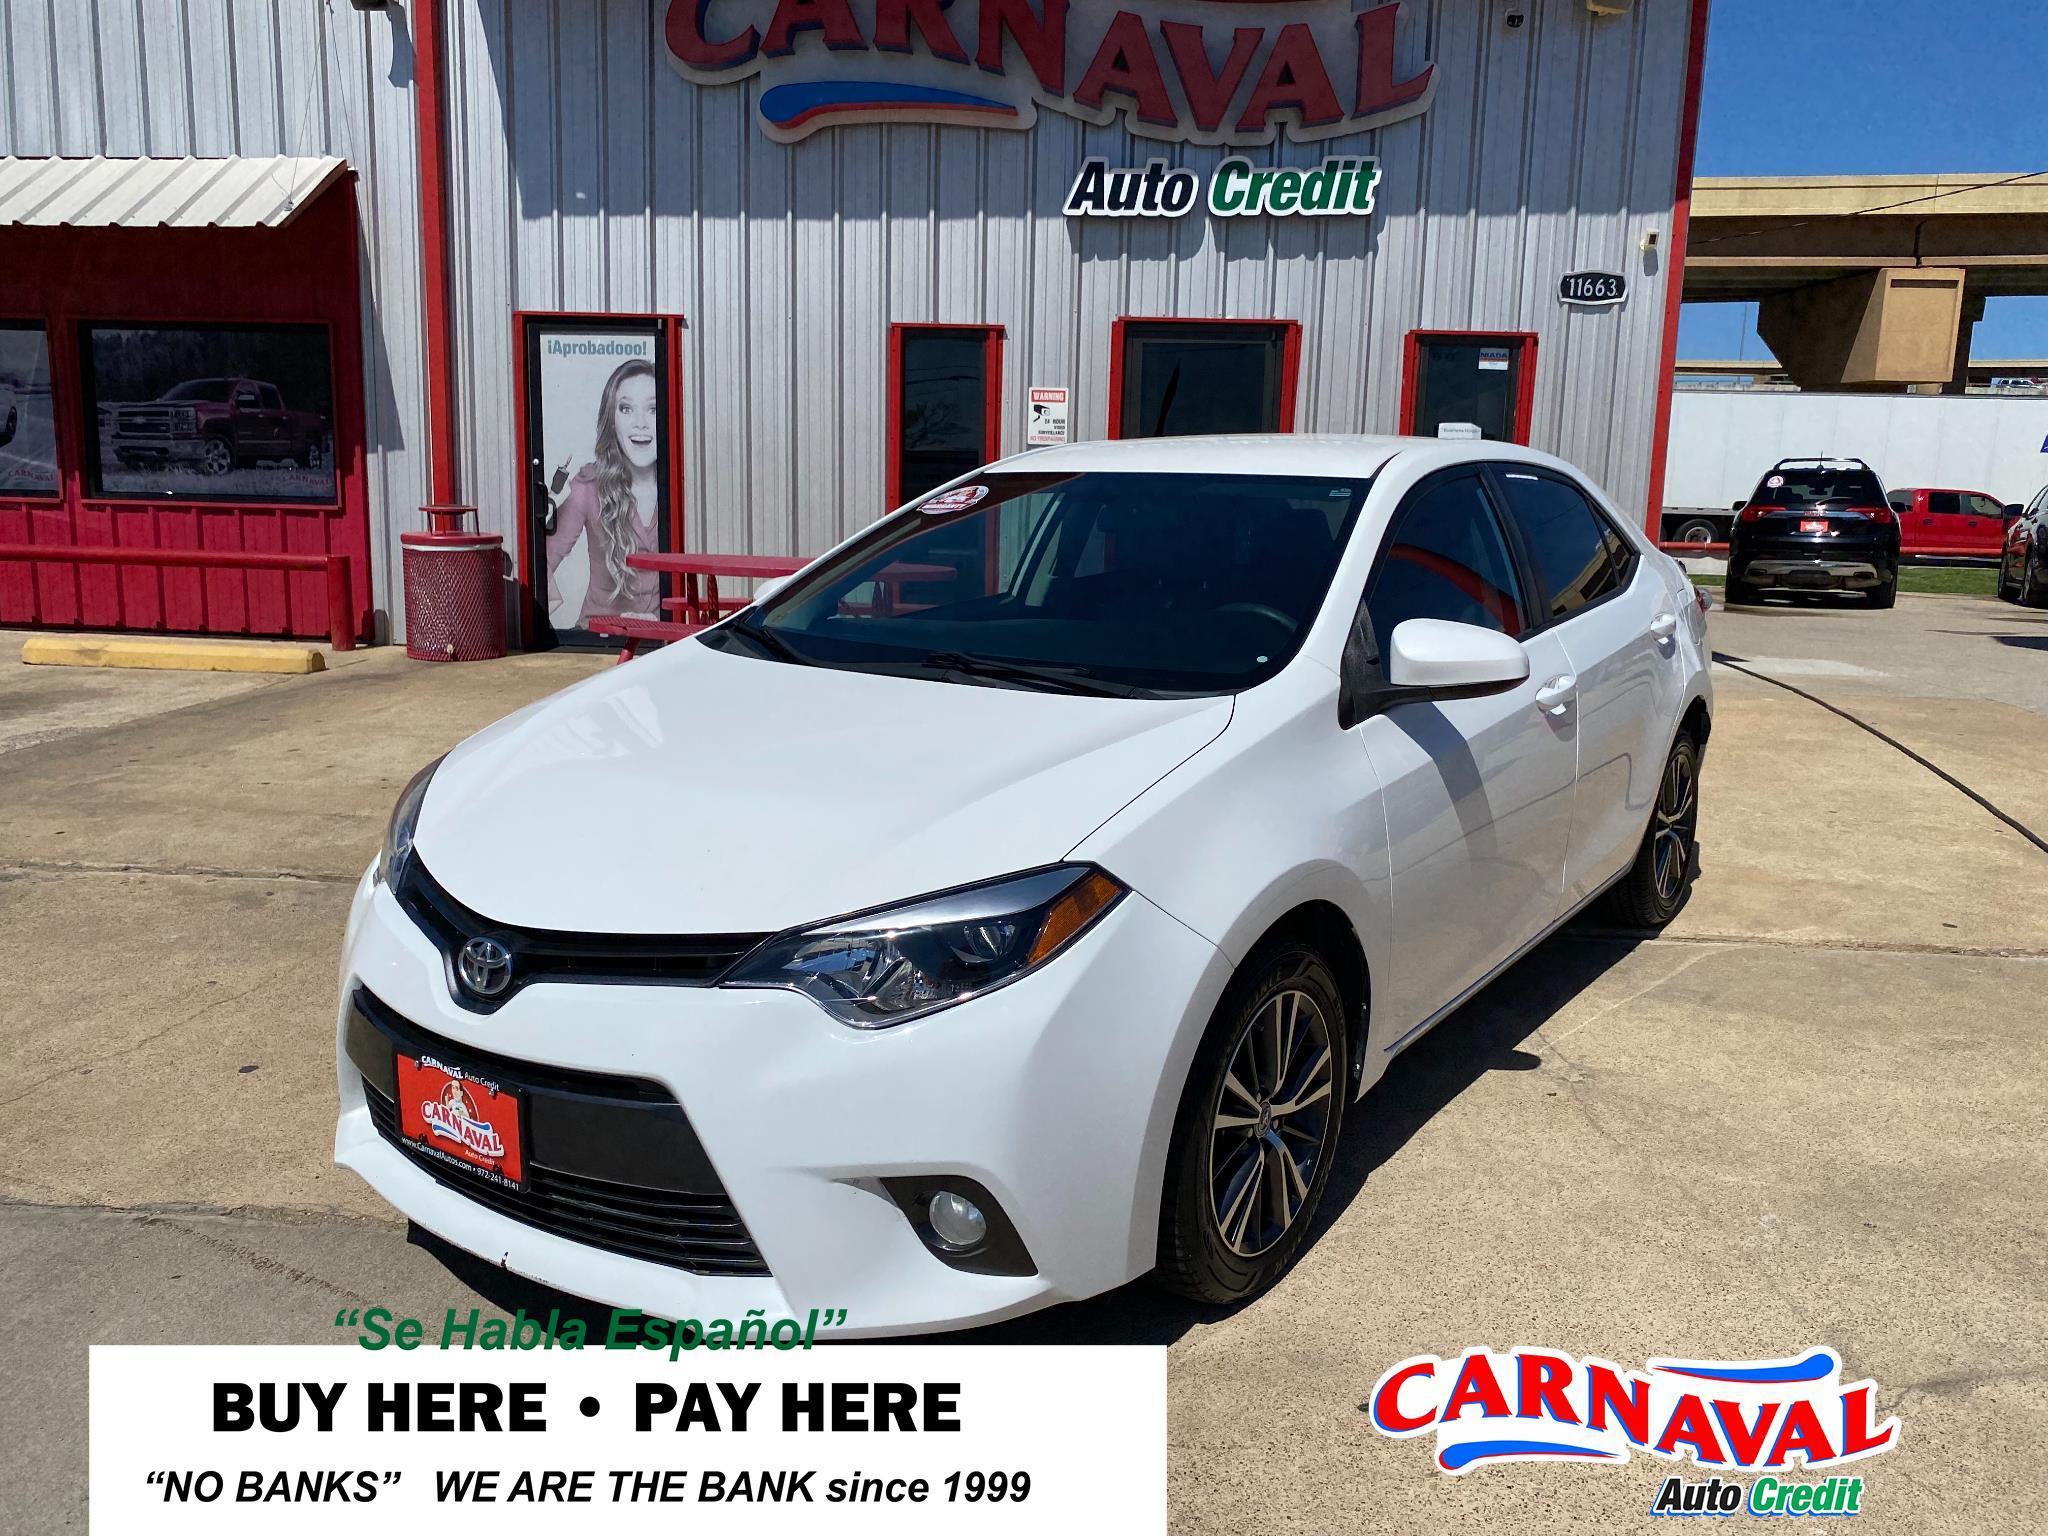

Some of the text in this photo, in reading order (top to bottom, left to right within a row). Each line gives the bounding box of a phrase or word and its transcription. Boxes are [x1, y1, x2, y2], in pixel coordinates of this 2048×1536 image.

[1067, 160, 1378, 213] Auto Credit
[1569, 278, 1617, 297] 11663
[1032, 391, 1065, 401] WARNING
[421, 1055, 500, 1091] CARNAVAL Auto Credit
[421, 1101, 504, 1154] CARNAVAL
[464, 1149, 478, 1161] Auto
